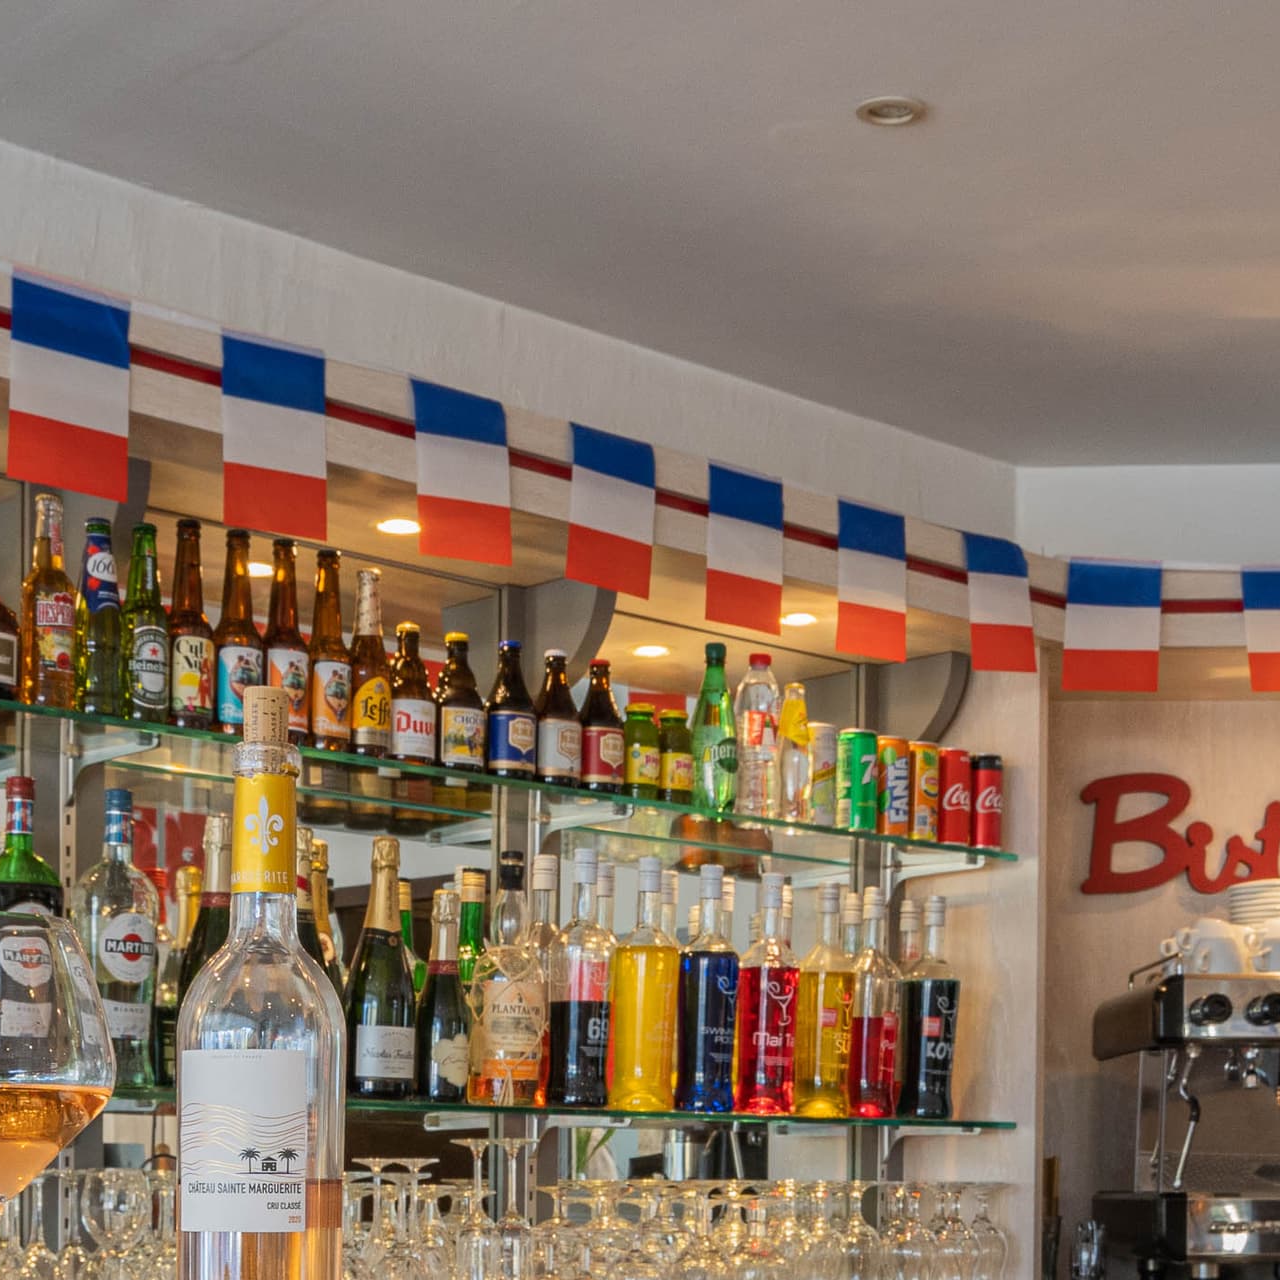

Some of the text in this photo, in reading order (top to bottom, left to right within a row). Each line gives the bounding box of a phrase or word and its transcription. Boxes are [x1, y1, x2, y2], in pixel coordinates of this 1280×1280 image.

[90, 559, 115, 575] 166
[176, 639, 203, 658] Cul
[396, 710, 434, 735] Duv
[888, 757, 908, 824] FANTA
[188, 1180, 302, 1194] CHÂTEAU SAINTE MARGUERITE
[267, 1201, 302, 1210] CRU CLASSÉ
